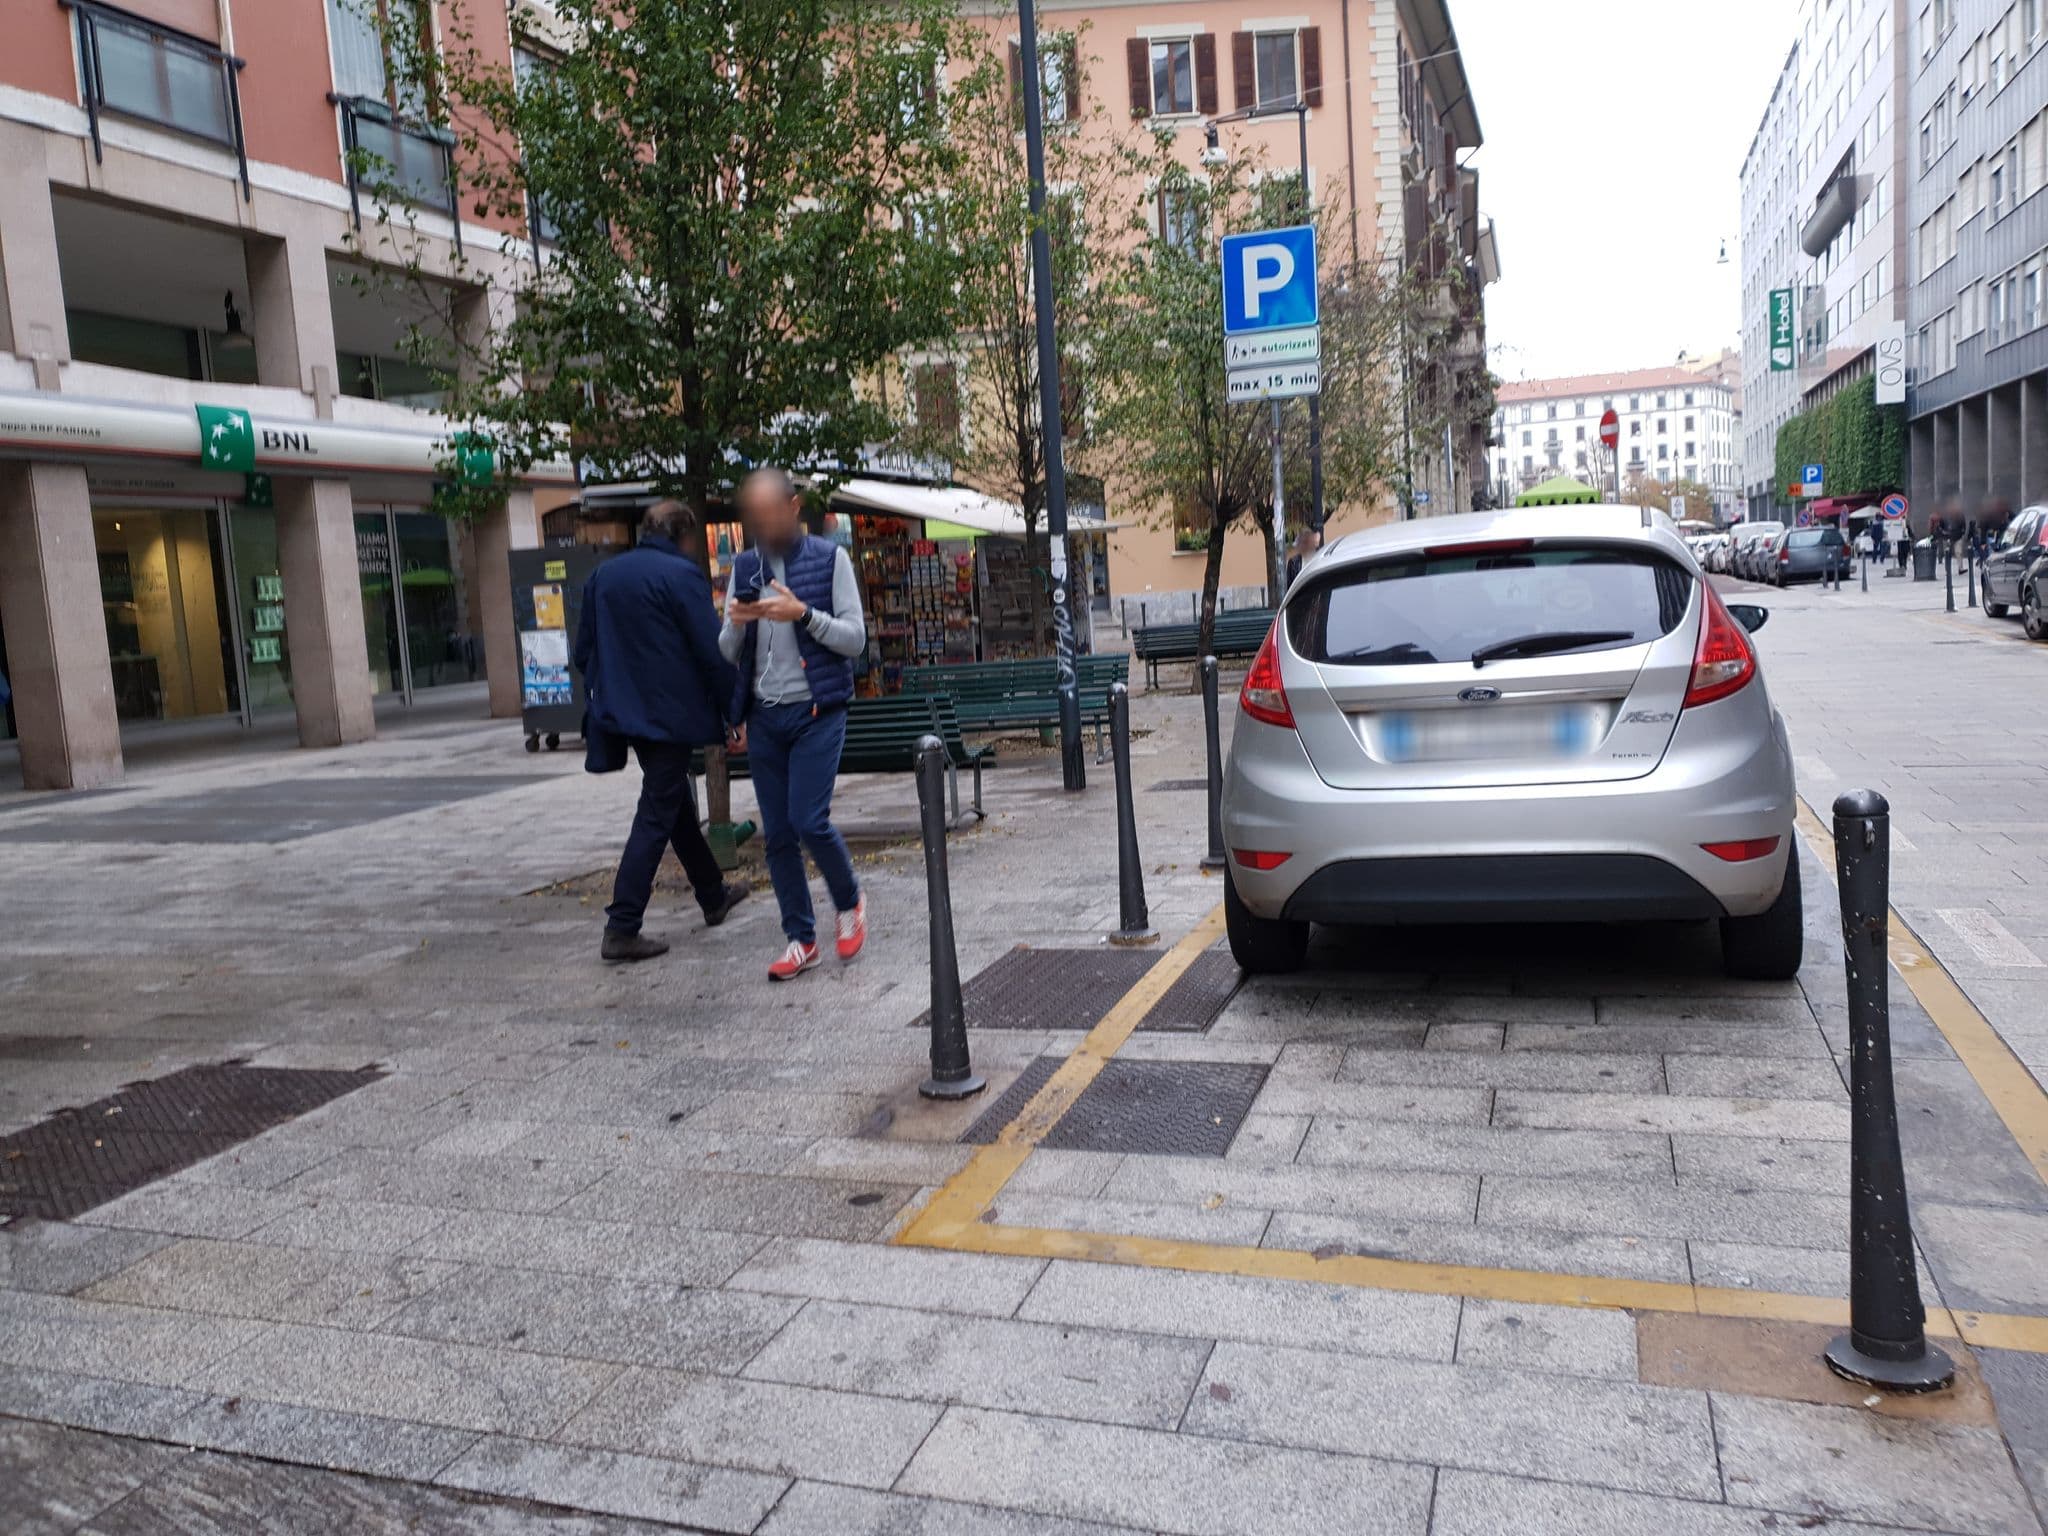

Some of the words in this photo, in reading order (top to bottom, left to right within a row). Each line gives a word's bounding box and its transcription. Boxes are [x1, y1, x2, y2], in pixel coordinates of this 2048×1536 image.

[1242, 243, 1295, 319] P
[1776, 292, 1790, 344] Hotel
[1261, 337, 1316, 354] autorizzati
[1879, 338, 1903, 387] OVS
[1231, 379, 1260, 393] max
[1268, 375, 1283, 389] 15
[1291, 373, 1317, 385] min
[262, 430, 318, 455] BNL
[1806, 467, 1818, 482] P
[1468, 690, 1490, 701] Ford
